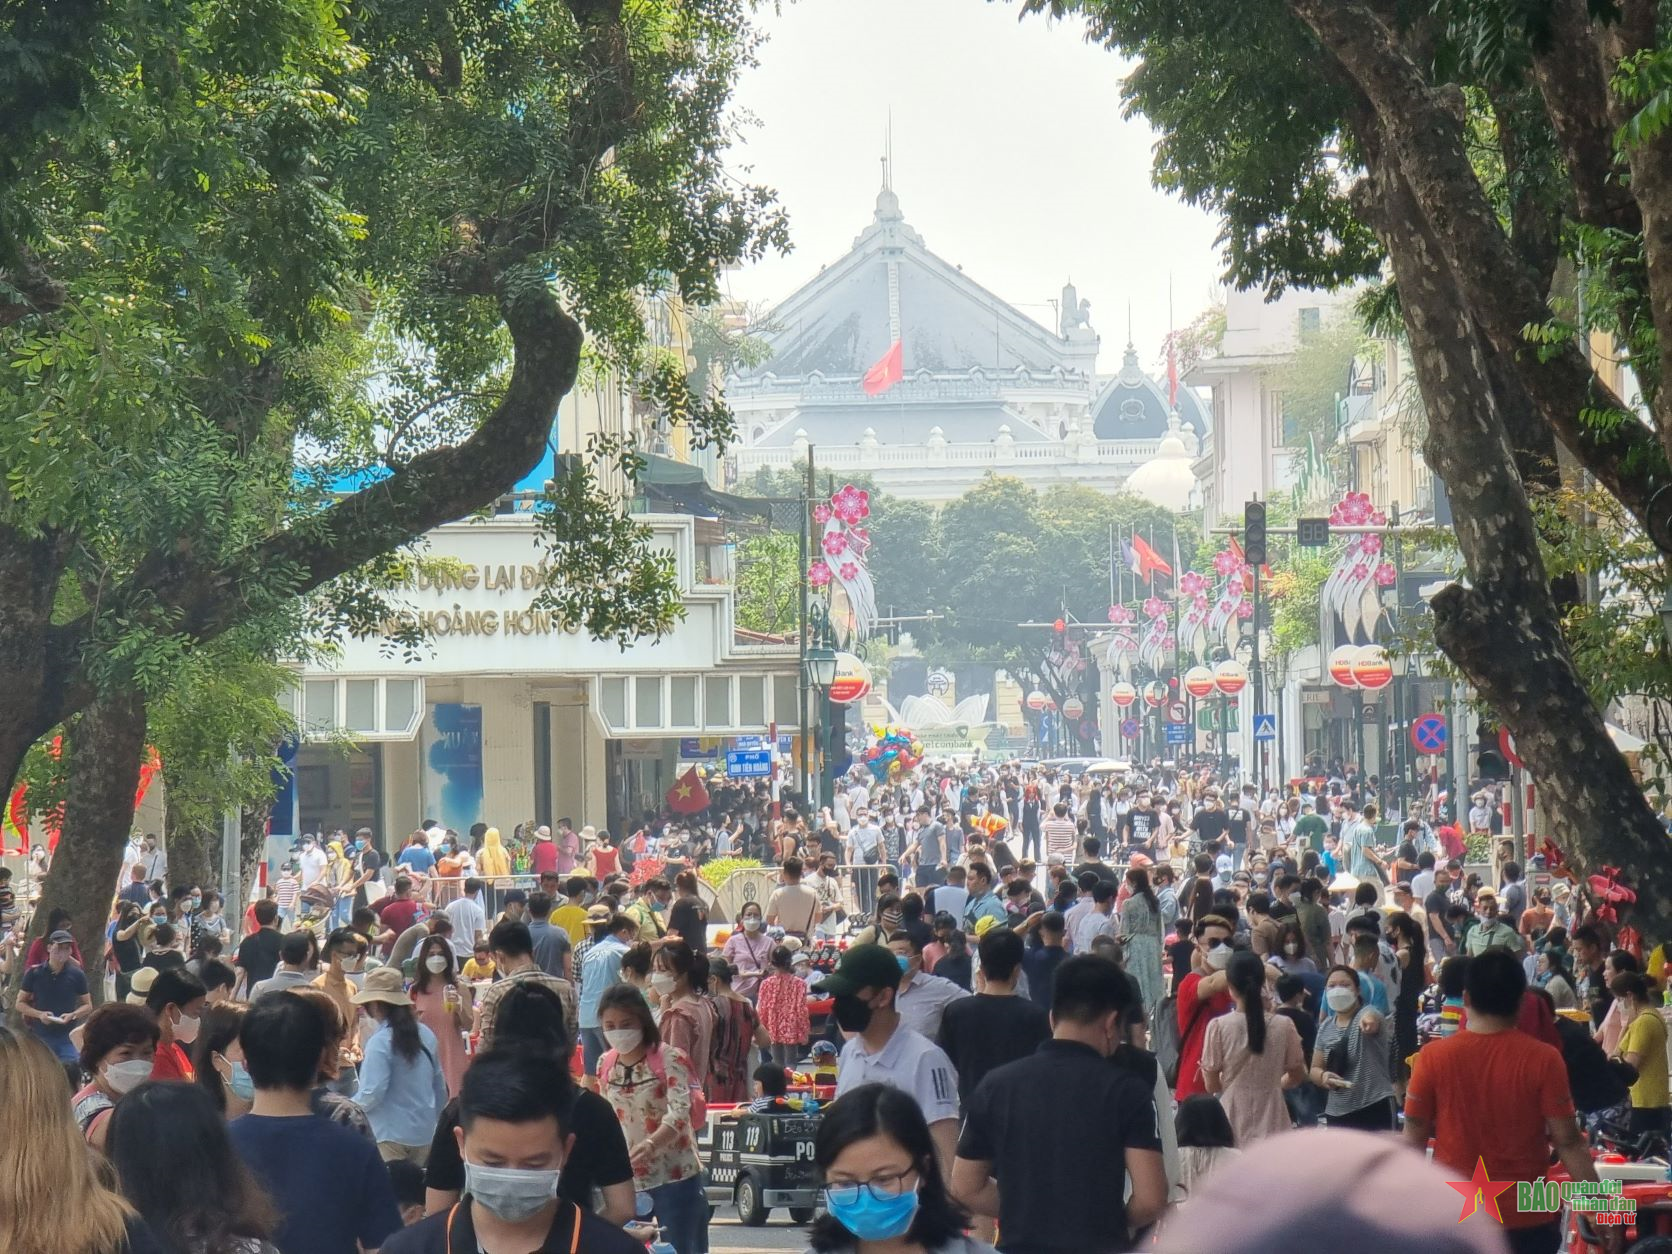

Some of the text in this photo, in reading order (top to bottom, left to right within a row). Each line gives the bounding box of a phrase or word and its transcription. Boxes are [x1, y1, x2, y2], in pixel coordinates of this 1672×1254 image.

[485, 565, 515, 597] LẠI
[745, 752, 760, 760] PHỐ
[722, 1131, 735, 1150] 113
[746, 1126, 760, 1147] 113
